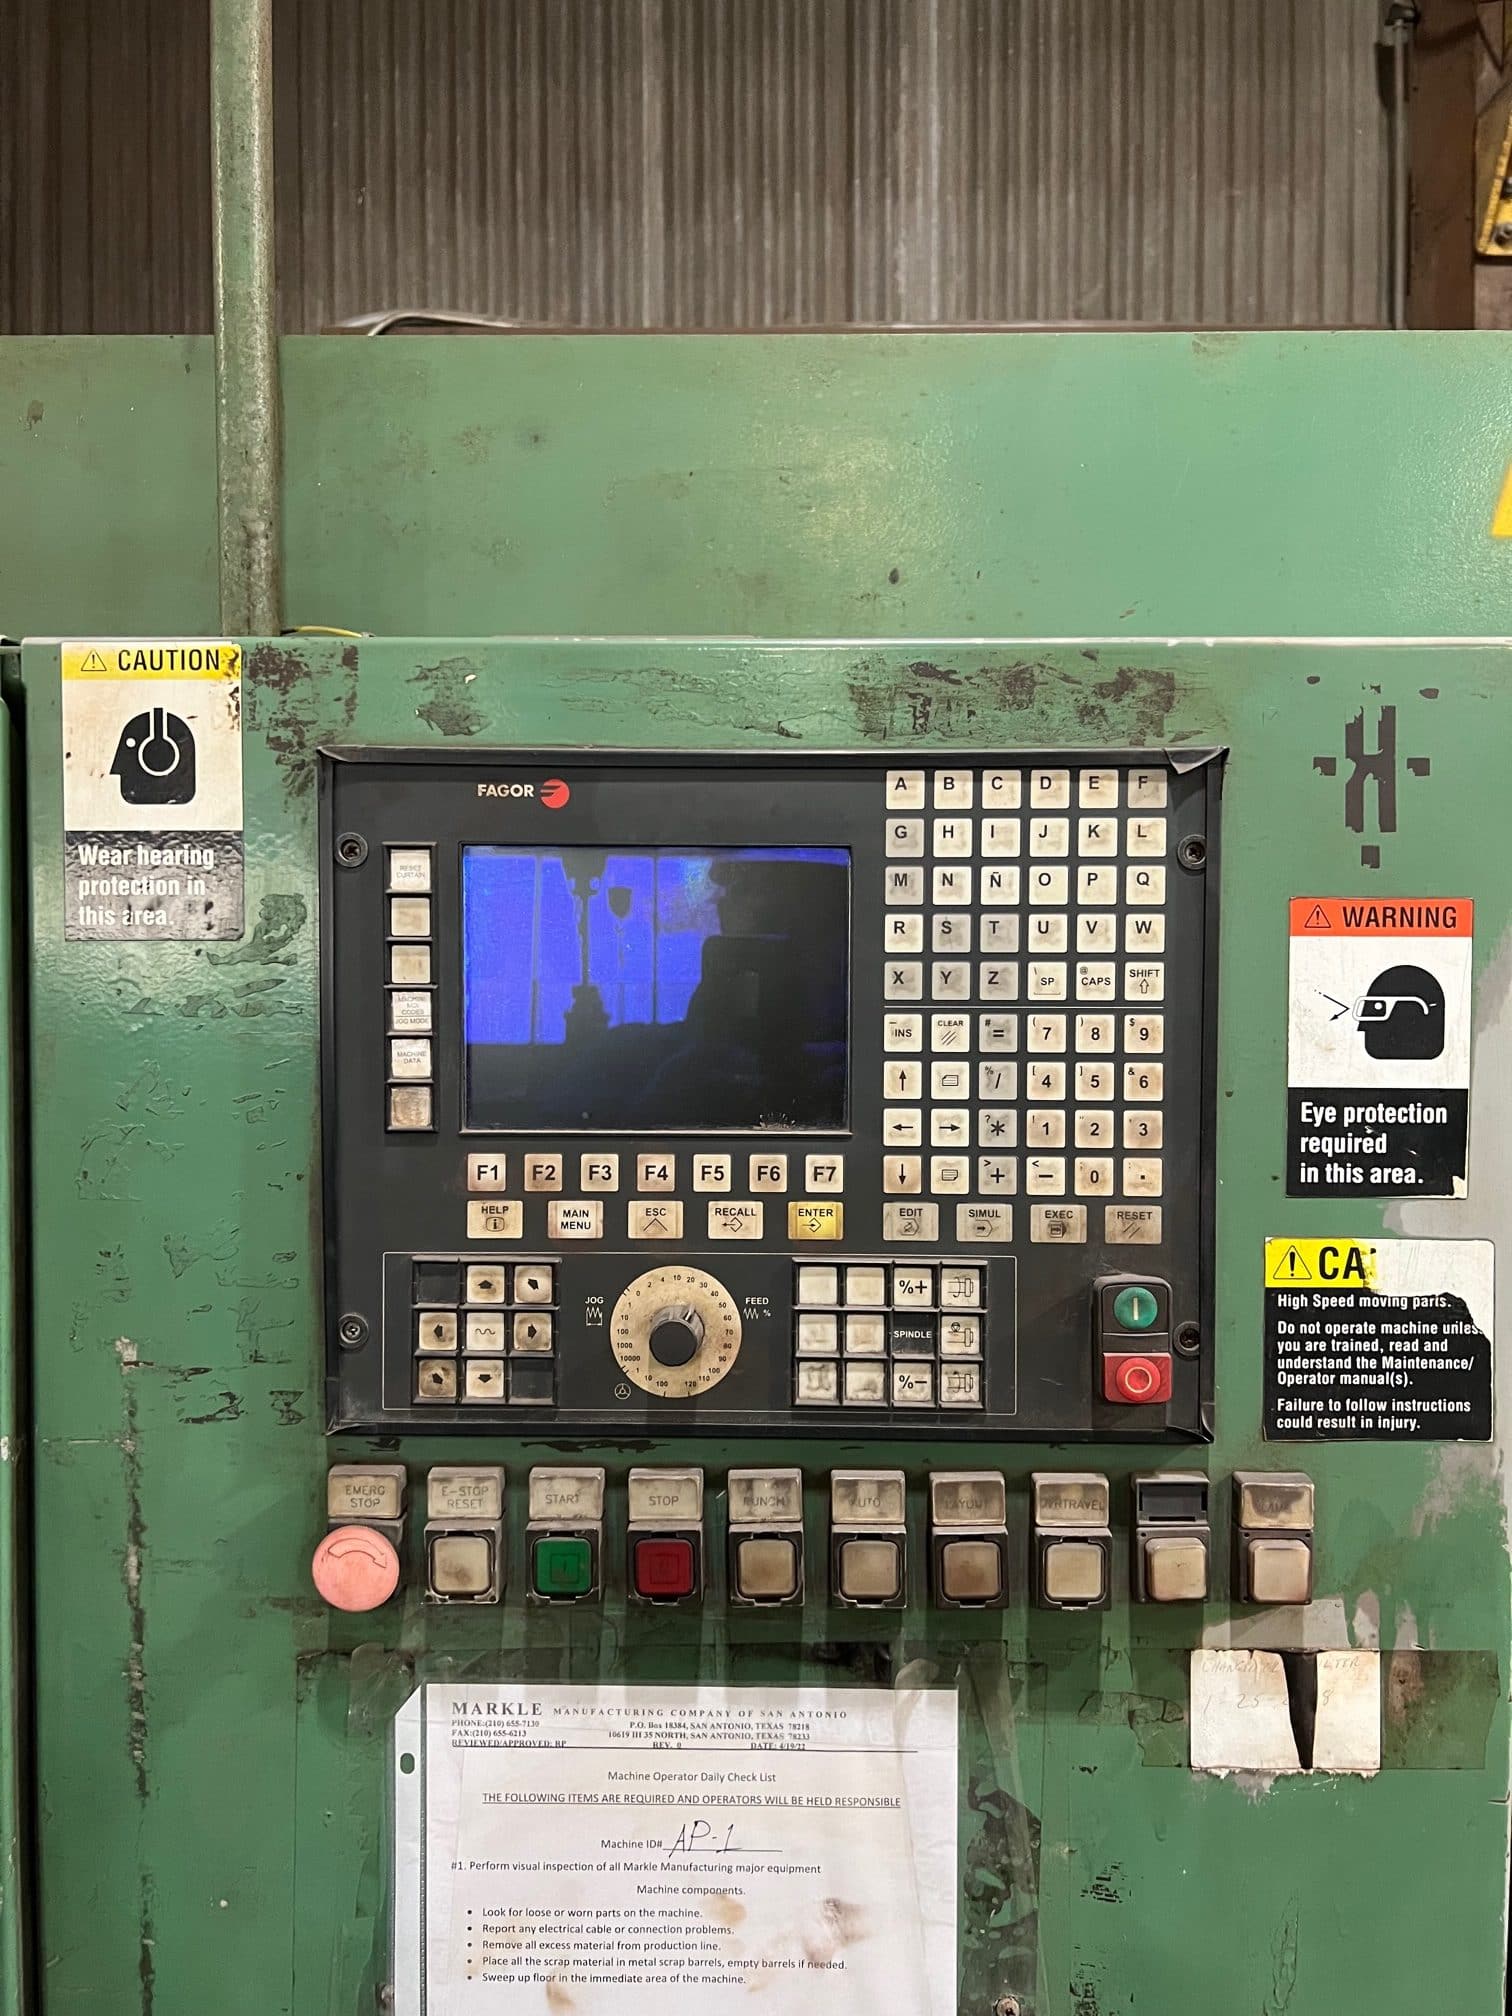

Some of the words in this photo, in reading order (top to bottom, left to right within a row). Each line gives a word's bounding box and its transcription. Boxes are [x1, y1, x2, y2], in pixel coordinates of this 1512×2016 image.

[118, 649, 220, 671] CAUTION
[895, 777, 907, 790] A
[944, 777, 955, 790] B
[992, 777, 1003, 790] C
[1040, 777, 1051, 790] D
[1089, 777, 1100, 790] E
[1138, 777, 1148, 790] F
[477, 784, 535, 798] FAGOR
[78, 846, 132, 866] Wear
[137, 844, 215, 870] hearing
[79, 876, 179, 898] protection
[187, 876, 205, 896] in
[79, 906, 116, 926] this
[122, 910, 175, 926] area.
[1343, 906, 1457, 929] WARNING
[1129, 969, 1160, 978] SHIFT
[1040, 978, 1054, 986] SP
[1081, 977, 1111, 986] CAPS
[894, 1029, 912, 1037] INS
[1043, 1028, 1051, 1040] 7
[1092, 1028, 1100, 1040] 8
[1140, 1028, 1148, 1040] 9
[1301, 1102, 1336, 1127] Eye
[1344, 1103, 1447, 1126] protection
[1301, 1133, 1387, 1156] required
[477, 1165, 499, 1181] F1
[533, 1165, 555, 1181] F2
[589, 1166, 611, 1181] F3
[645, 1166, 668, 1181] F4
[701, 1166, 724, 1181] F5
[757, 1166, 780, 1182] F6
[814, 1166, 836, 1182] F7
[1300, 1163, 1318, 1183] in
[1325, 1163, 1363, 1184] this
[1370, 1167, 1423, 1184] area.
[481, 1205, 509, 1214] HELP
[646, 1208, 666, 1216] ESC
[715, 1208, 756, 1217] RECALL
[798, 1208, 833, 1217] ENTER
[900, 1208, 922, 1216] EDIT
[968, 1210, 1000, 1218] SIMUL
[1045, 1210, 1073, 1219] EXEC
[1117, 1212, 1152, 1220] RESET
[561, 1221, 591, 1230] MENU
[1319, 1246, 1376, 1280] CA
[746, 1297, 769, 1305] FEED
[1278, 1295, 1308, 1310] High
[1313, 1295, 1354, 1310] Speed
[1359, 1296, 1407, 1310] moving
[1278, 1321, 1295, 1334] Do
[1300, 1322, 1320, 1334] not
[1325, 1323, 1375, 1337] operate
[1381, 1322, 1438, 1334] machine
[1277, 1342, 1300, 1354] you
[1305, 1342, 1326, 1352] are
[1331, 1339, 1383, 1353] trained,
[1389, 1339, 1418, 1352] read
[1424, 1339, 1448, 1352] and
[1278, 1357, 1351, 1369] understand
[1356, 1357, 1377, 1369] the
[1382, 1357, 1474, 1370] Maintenance/
[1278, 1372, 1335, 1387] Operator
[1340, 1373, 1413, 1387] manual(s).
[1277, 1399, 1323, 1412] Failure
[1329, 1400, 1341, 1412] to
[1346, 1399, 1387, 1412] follow
[1392, 1399, 1471, 1412] instructions
[1277, 1417, 1312, 1429] could
[1318, 1417, 1356, 1429] result
[1361, 1417, 1373, 1429] in
[1378, 1417, 1420, 1431] injury.
[345, 1485, 385, 1495] EMERG
[442, 1486, 489, 1496] E-STOP
[350, 1498, 380, 1508] STOP
[448, 1499, 483, 1509] RESET
[545, 1494, 580, 1505] START
[649, 1496, 679, 1506] STOP
[452, 1703, 542, 1716] MARKLE
[554, 1708, 663, 1716] MANUFACTURING
[670, 1708, 730, 1718] COMPANY
[790, 1711, 847, 1719] ANTONIO
[608, 1771, 650, 1781] Machine
[653, 1772, 697, 1783] Operator
[701, 1773, 725, 1784] Daily
[728, 1773, 757, 1782] Check
[760, 1773, 776, 1782] List
[483, 1793, 502, 1802] THE
[505, 1793, 565, 1802] FOLLOWING
[568, 1794, 599, 1802] ITEMS
[602, 1794, 620, 1803] ARE
[624, 1794, 675, 1804] REQUIRED
[677, 1794, 700, 1804] AND
[703, 1796, 761, 1805] OPERATORS
[765, 1796, 789, 1805] WILL
[792, 1797, 803, 1805] BE
[807, 1797, 832, 1805] HELD
[835, 1798, 901, 1806] RESPONSIBLE
[601, 1840, 643, 1848] Machine
[647, 1840, 662, 1848] ID#
[668, 1820, 742, 1858] AP-1
[451, 1862, 466, 1870] #1.
[470, 1861, 509, 1871] Perform
[513, 1862, 540, 1871] visual
[543, 1863, 593, 1873] inspection
[597, 1863, 606, 1871] of
[609, 1863, 620, 1871] all
[624, 1863, 657, 1872] Markle
[661, 1863, 732, 1874] Manufacturing
[735, 1864, 764, 1874] major
[767, 1864, 820, 1874] equipment
[637, 1885, 679, 1894] Machine
[682, 1886, 746, 1896] components.
[482, 1908, 505, 1917] Look
[508, 1908, 522, 1917] for
[526, 1909, 551, 1917] loose
[596, 1909, 620, 1919] parts
[639, 1909, 655, 1917] the
[658, 1909, 702, 1918] machine.
[483, 1925, 515, 1935] Report
[519, 1927, 535, 1935] any
[539, 1925, 583, 1933] electrical
[586, 1925, 611, 1934] cable
[628, 1925, 682, 1934] connection
[685, 1925, 734, 1935] problems.
[482, 1974, 514, 1984] Sweep
[518, 1976, 530, 1984] up
[533, 1973, 555, 1983] floor
[559, 1974, 568, 1983] in
[571, 1974, 587, 1983] the
[590, 1974, 642, 1983] immediate
[670, 1975, 679, 1983] of
[683, 1975, 699, 1983] the
[702, 1975, 746, 1984] machine.
